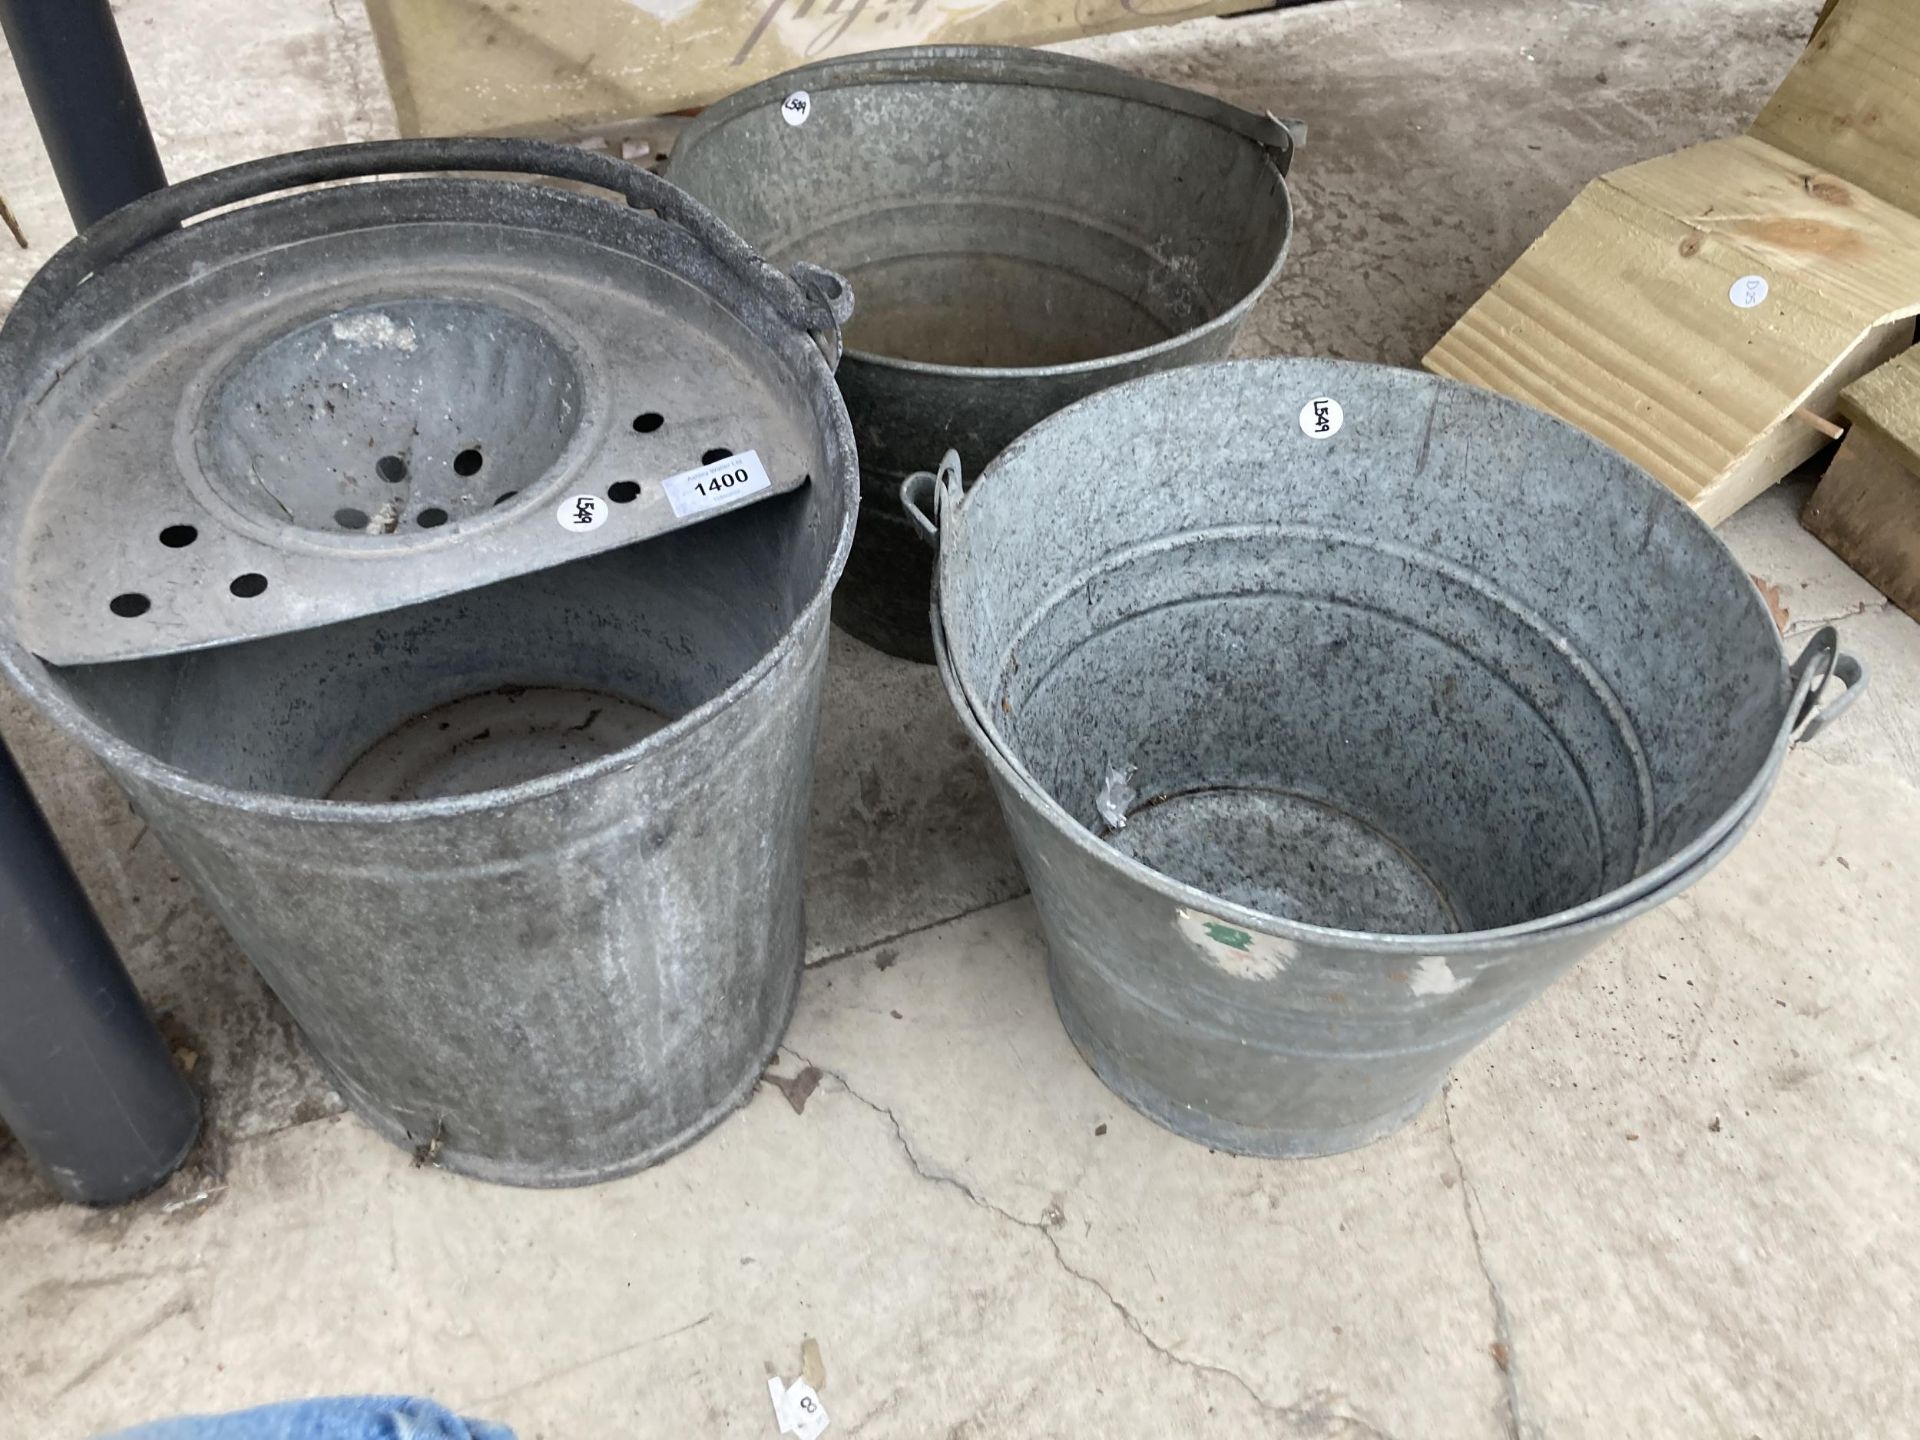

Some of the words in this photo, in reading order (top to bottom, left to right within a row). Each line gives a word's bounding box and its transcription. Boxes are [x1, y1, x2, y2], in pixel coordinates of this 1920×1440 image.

[1313, 400, 1329, 432] L549
[694, 468, 748, 496] 1400
[573, 497, 594, 523] L549
